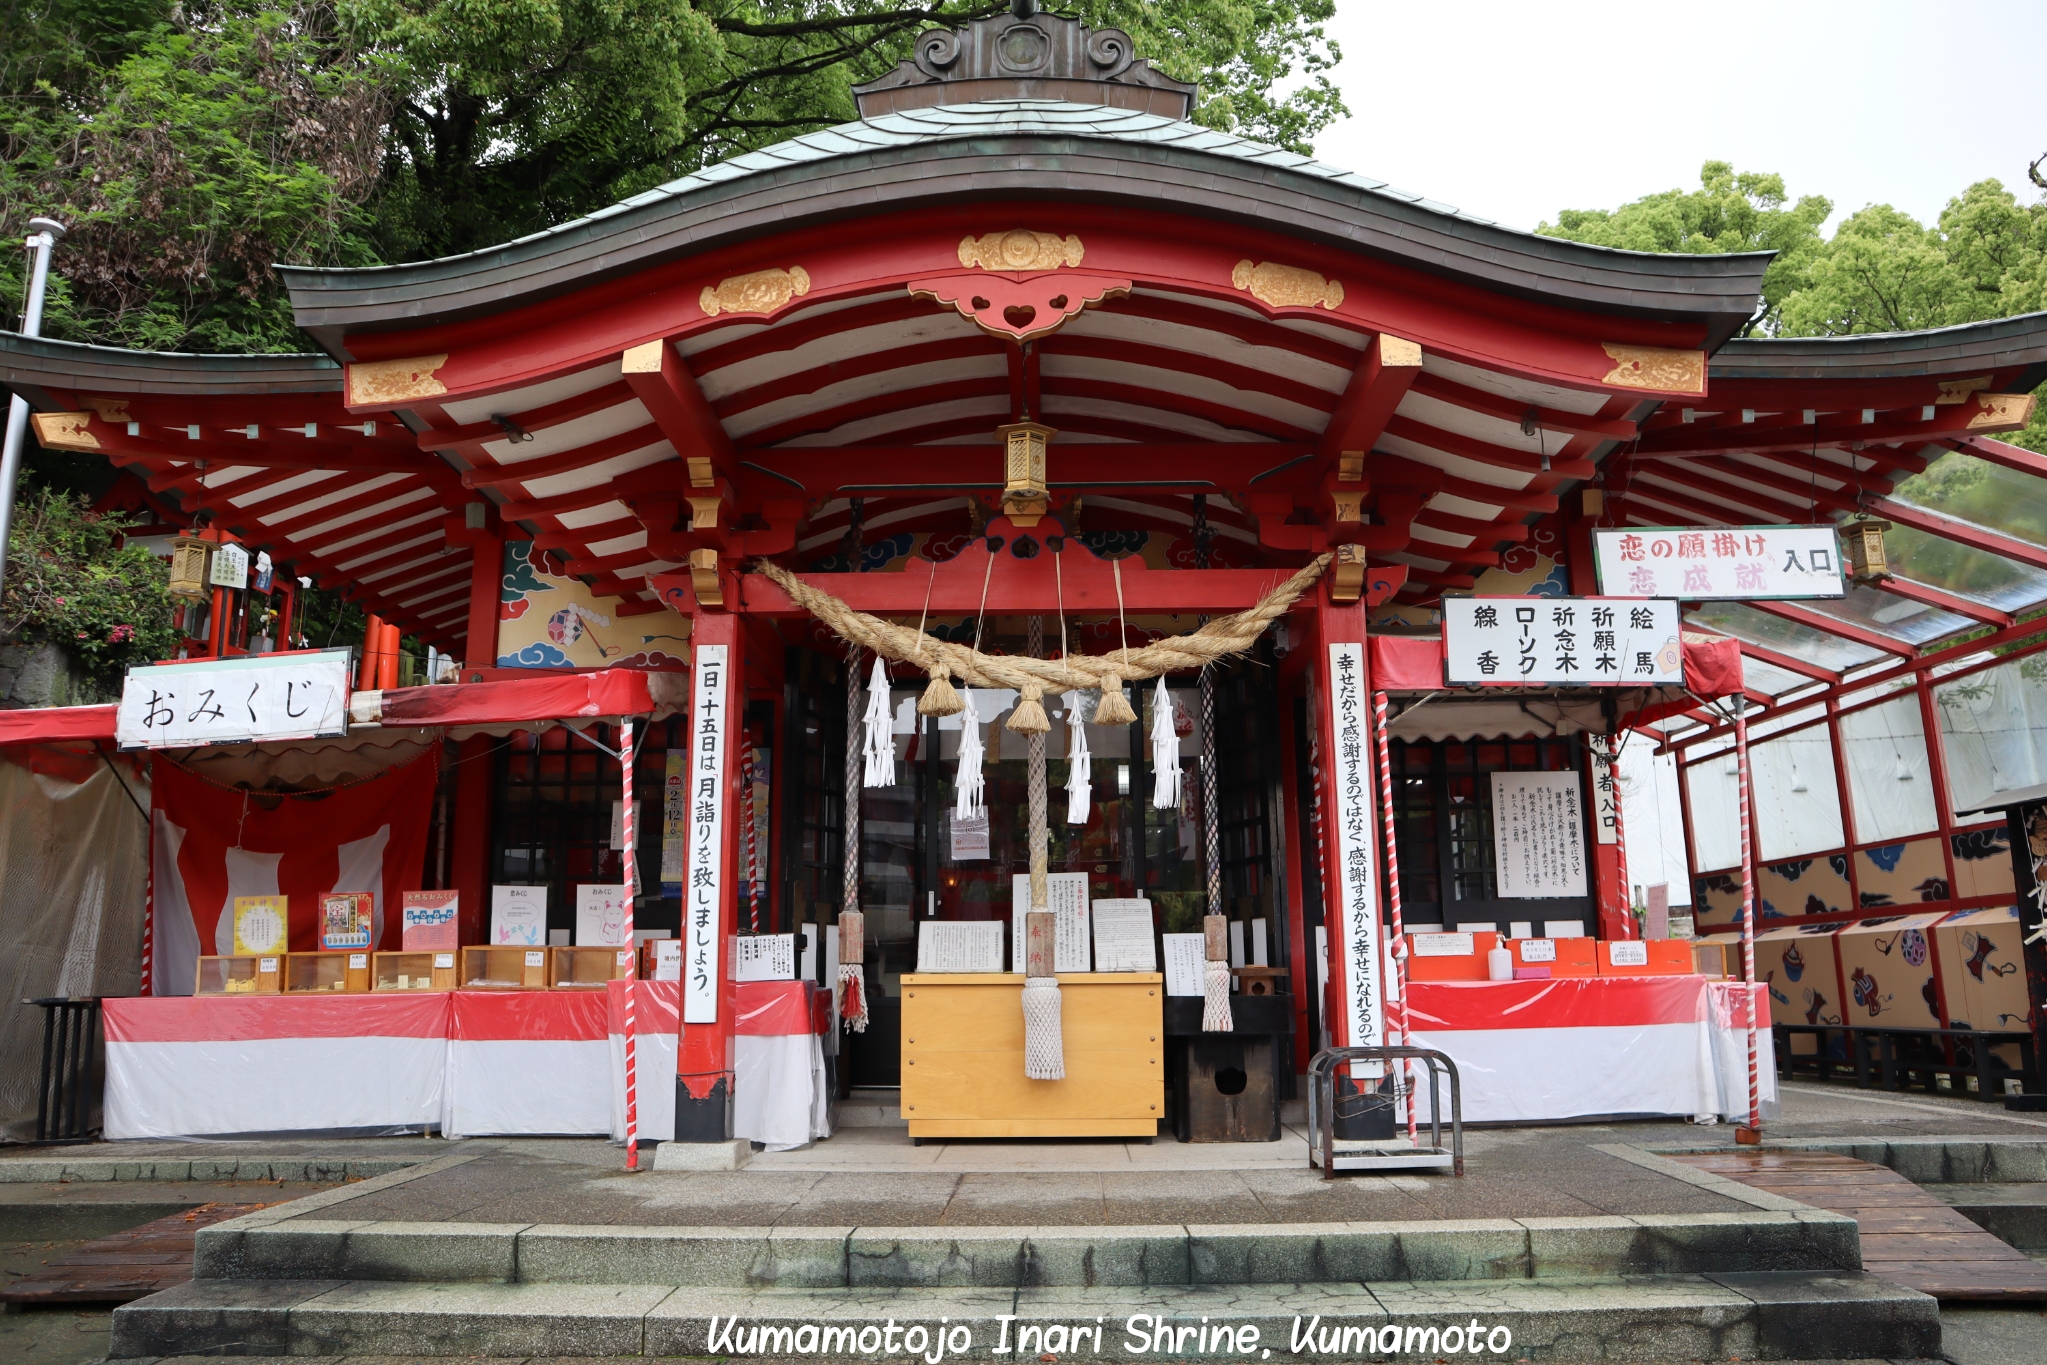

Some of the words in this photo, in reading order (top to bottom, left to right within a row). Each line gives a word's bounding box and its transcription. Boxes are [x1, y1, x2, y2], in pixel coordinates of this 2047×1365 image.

[1618, 533, 1767, 561] 恋の願掛け
[1782, 549, 1832, 573] 入口
[1628, 562, 1769, 594] 恋成就
[1473, 605, 1500, 675] 線香
[1515, 607, 1537, 675] ローソク
[1552, 606, 1579, 674] 祈念木
[1591, 606, 1618, 675] 祈願木
[1630, 607, 1655, 675] 絵馬
[142, 680, 312, 729] おみくじ
[1337, 653, 1376, 1065] 幸せだから感謝するのではなく、感謝するから幸せになれるので。
[406, 892, 454, 901] 天然石おみくじ
[1029, 924, 1042, 964] 奉納
